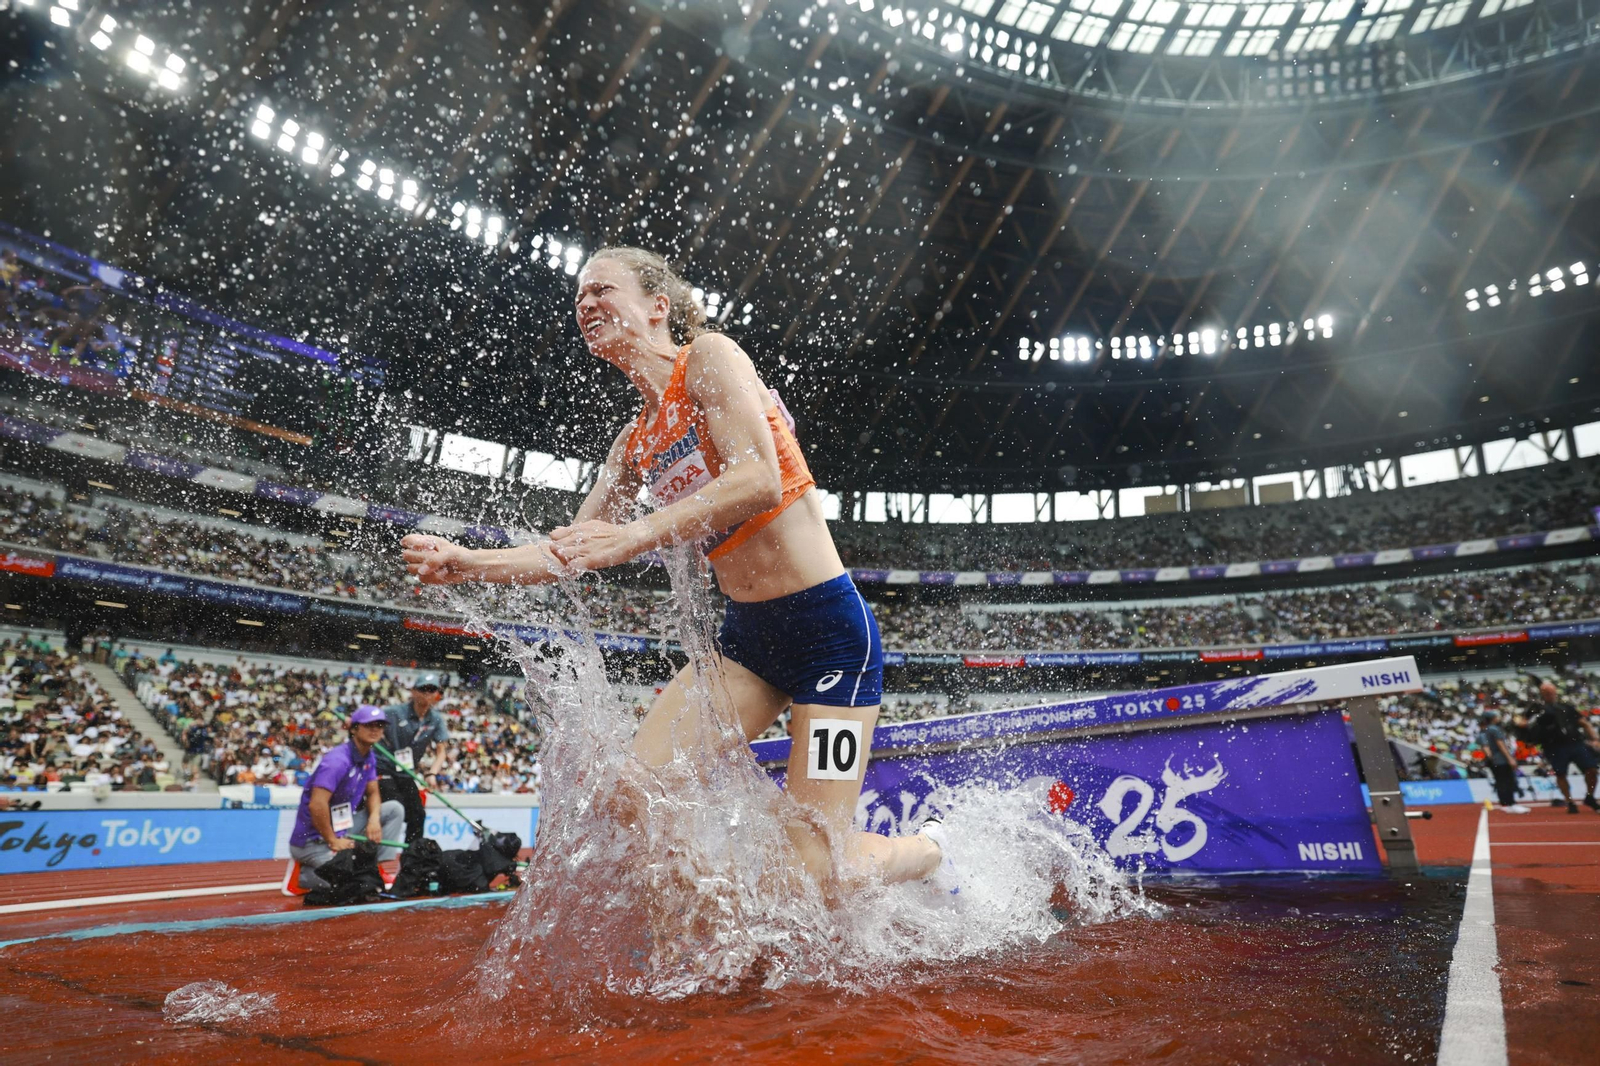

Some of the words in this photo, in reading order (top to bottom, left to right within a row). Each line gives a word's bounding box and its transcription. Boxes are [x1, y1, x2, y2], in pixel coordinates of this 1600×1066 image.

[1361, 670, 1411, 689] NISHI
[1183, 694, 1206, 709] 25
[889, 729, 928, 743] WORLD
[931, 720, 990, 739] ATHLETICS
[993, 707, 1097, 730] CHAMPIONSHIPS
[812, 728, 858, 772] 10
[1405, 785, 1443, 801] Tokyo
[1099, 753, 1228, 862] 25
[101, 819, 202, 853] Tokyo
[425, 815, 474, 842] oky
[1297, 842, 1363, 862] NISHI
